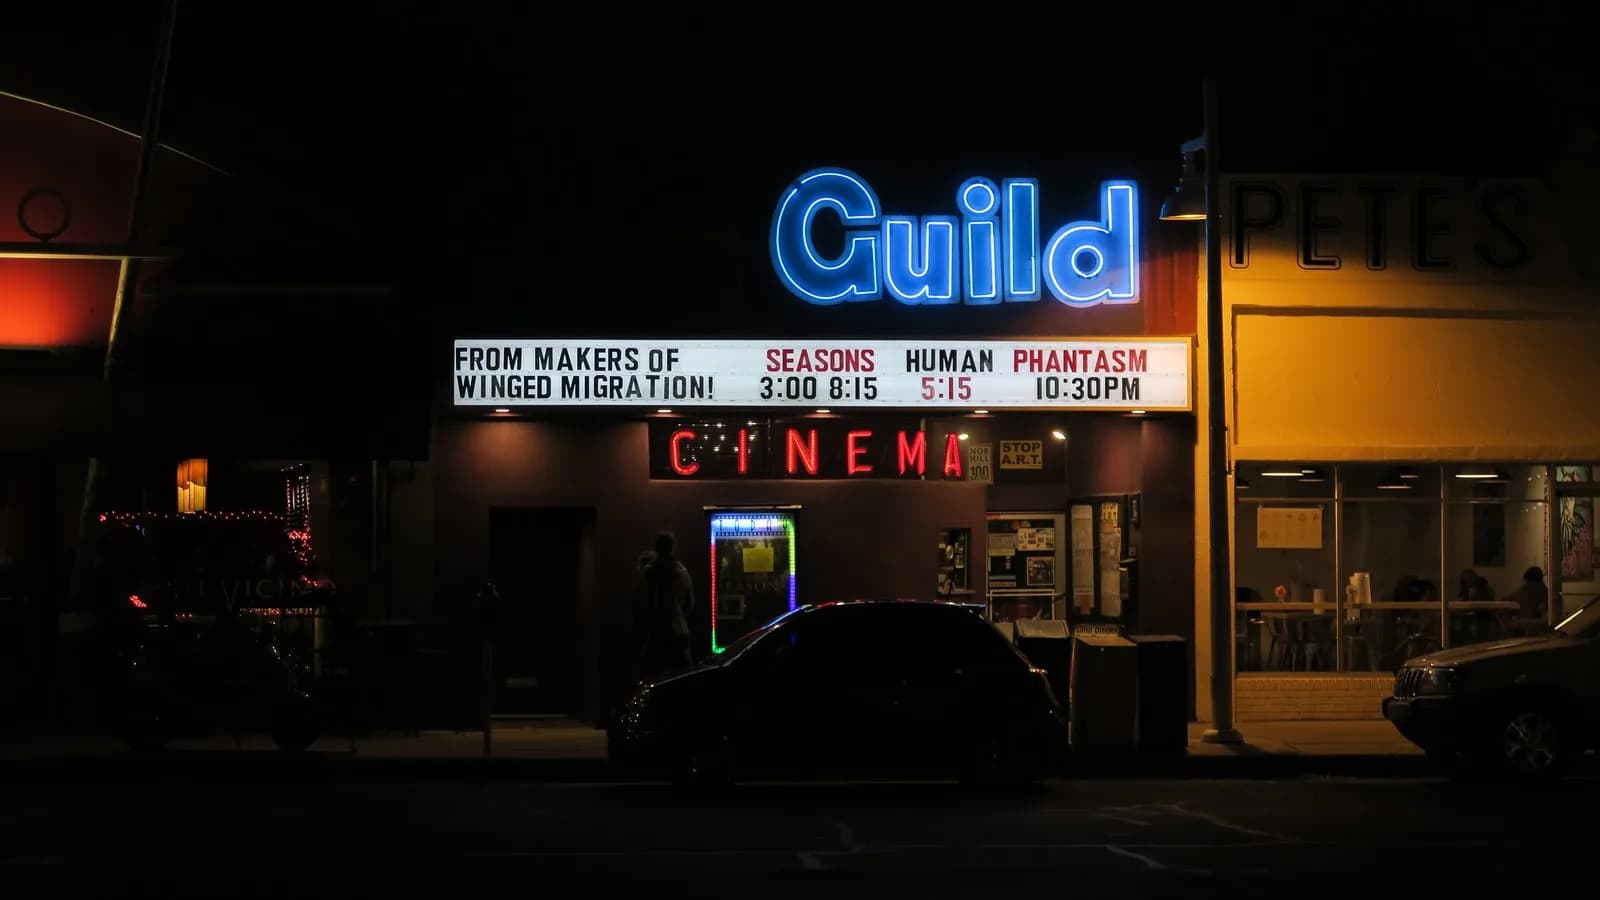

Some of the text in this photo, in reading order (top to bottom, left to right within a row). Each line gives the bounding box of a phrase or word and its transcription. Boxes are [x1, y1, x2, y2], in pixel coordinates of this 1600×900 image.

[769, 167, 1140, 308] Guild
[455, 347, 680, 372] FROM MAKERS OF
[766, 349, 876, 372] SEASONS
[906, 349, 993, 373] HUMAN
[1013, 349, 1148, 373] PHANTASM
[456, 375, 715, 399] WINGED MIGRATION!
[759, 376, 878, 400] 3:00 8:15
[921, 376, 973, 400] 5:15
[1036, 377, 1140, 401] 10:30PM
[669, 428, 964, 477] CINEMA
[1002, 442, 1041, 453] STOP
[1002, 454, 1041, 465] A.R.T.
